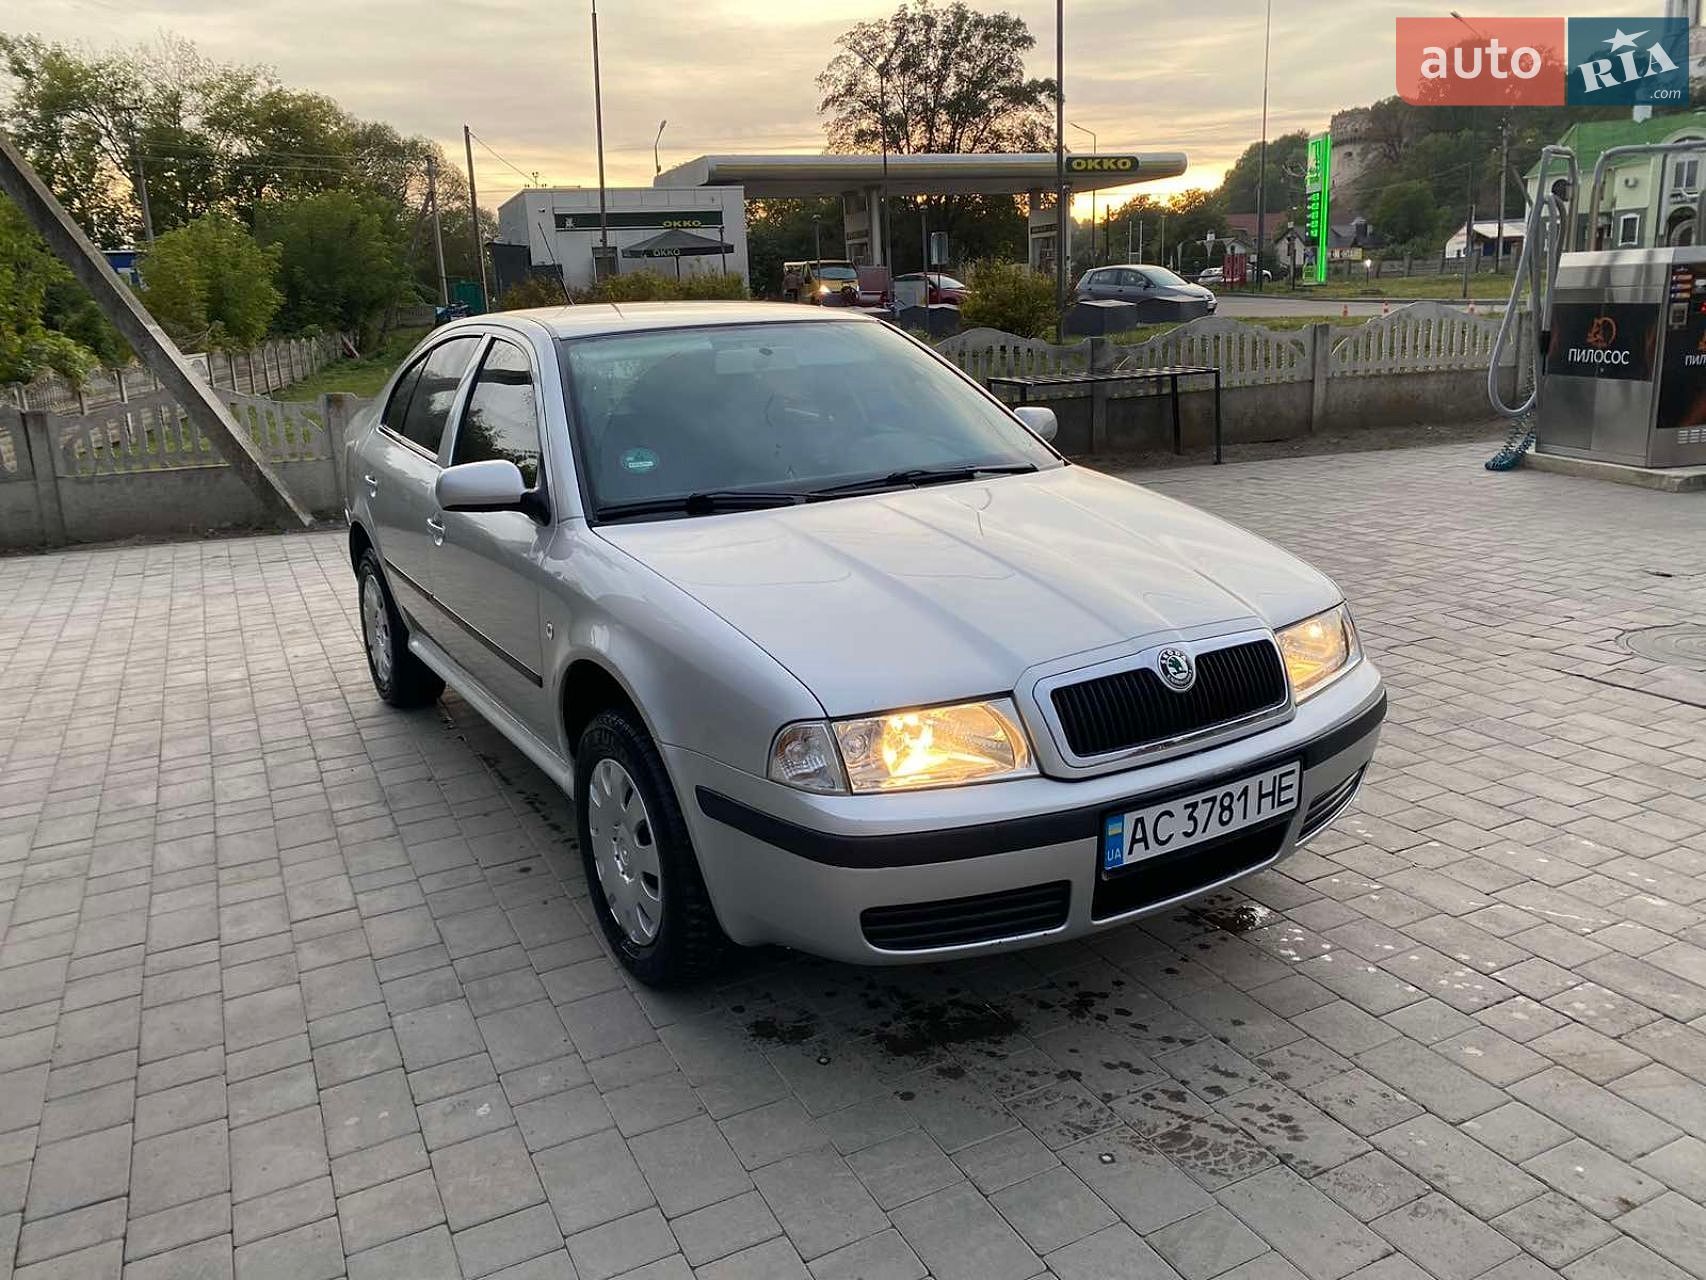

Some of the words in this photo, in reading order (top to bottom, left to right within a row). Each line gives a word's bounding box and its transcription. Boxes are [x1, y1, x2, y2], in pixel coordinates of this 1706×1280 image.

[1072, 159, 1131, 169] OKKO
[663, 220, 701, 228] OKKO
[1568, 348, 1630, 364] ПИЛОСОС
[1128, 810, 1175, 855] AC
[1182, 785, 1249, 838] 3781
[1257, 769, 1295, 815] HE
[1107, 849, 1122, 861] UA
